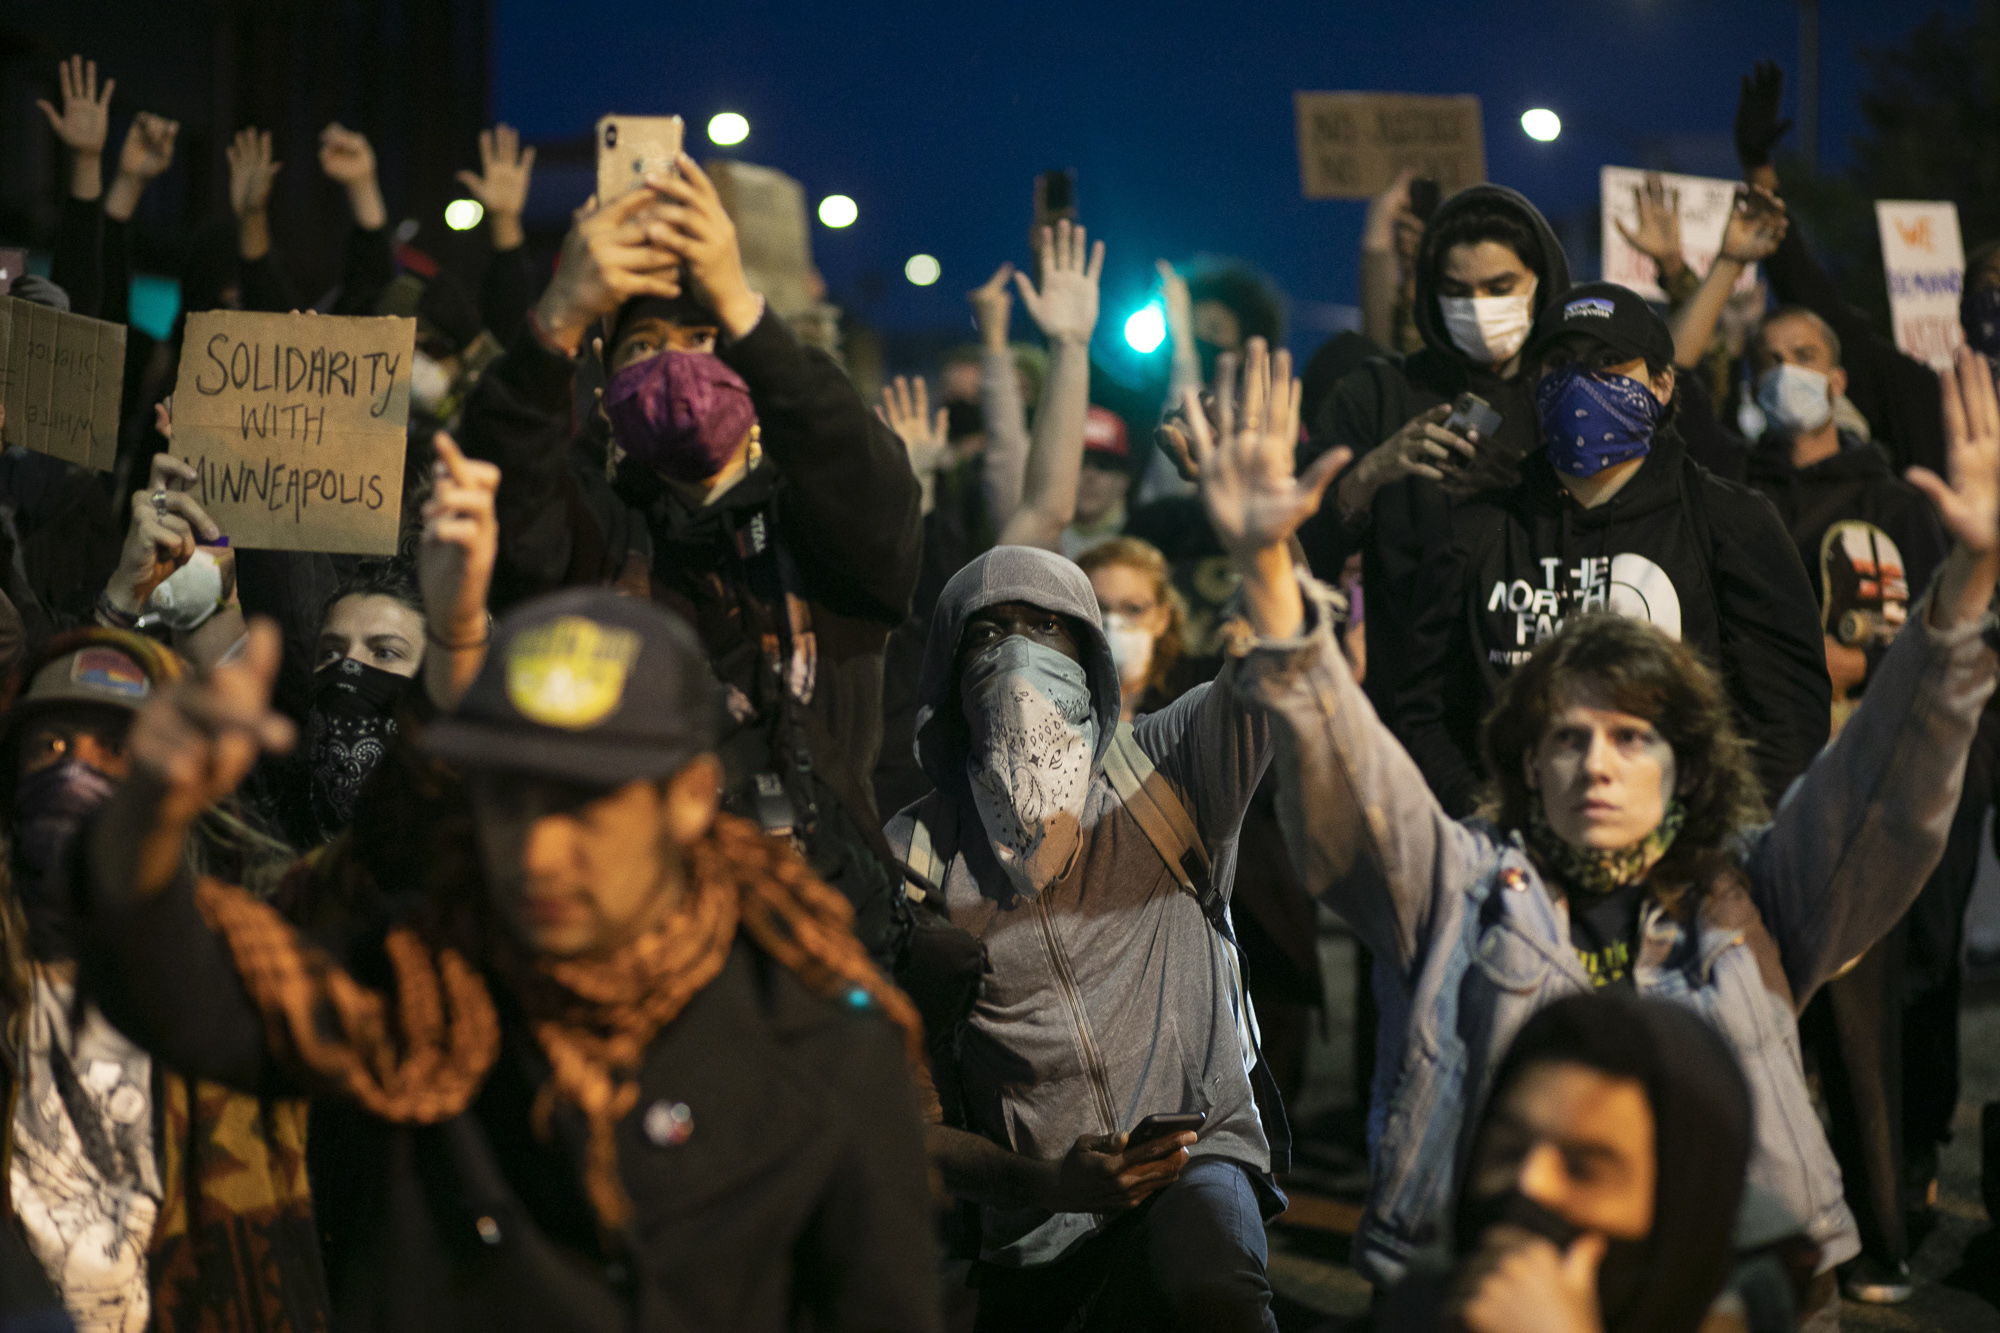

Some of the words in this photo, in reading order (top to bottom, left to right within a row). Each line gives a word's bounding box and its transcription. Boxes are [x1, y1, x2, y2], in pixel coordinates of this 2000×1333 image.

[1893, 213, 1938, 255] WE
[196, 333, 400, 418] SOLIDARITY
[241, 402, 325, 445] WITH
[182, 456, 384, 523] MINNEAPOLIS
[1540, 556, 1609, 588] THE
